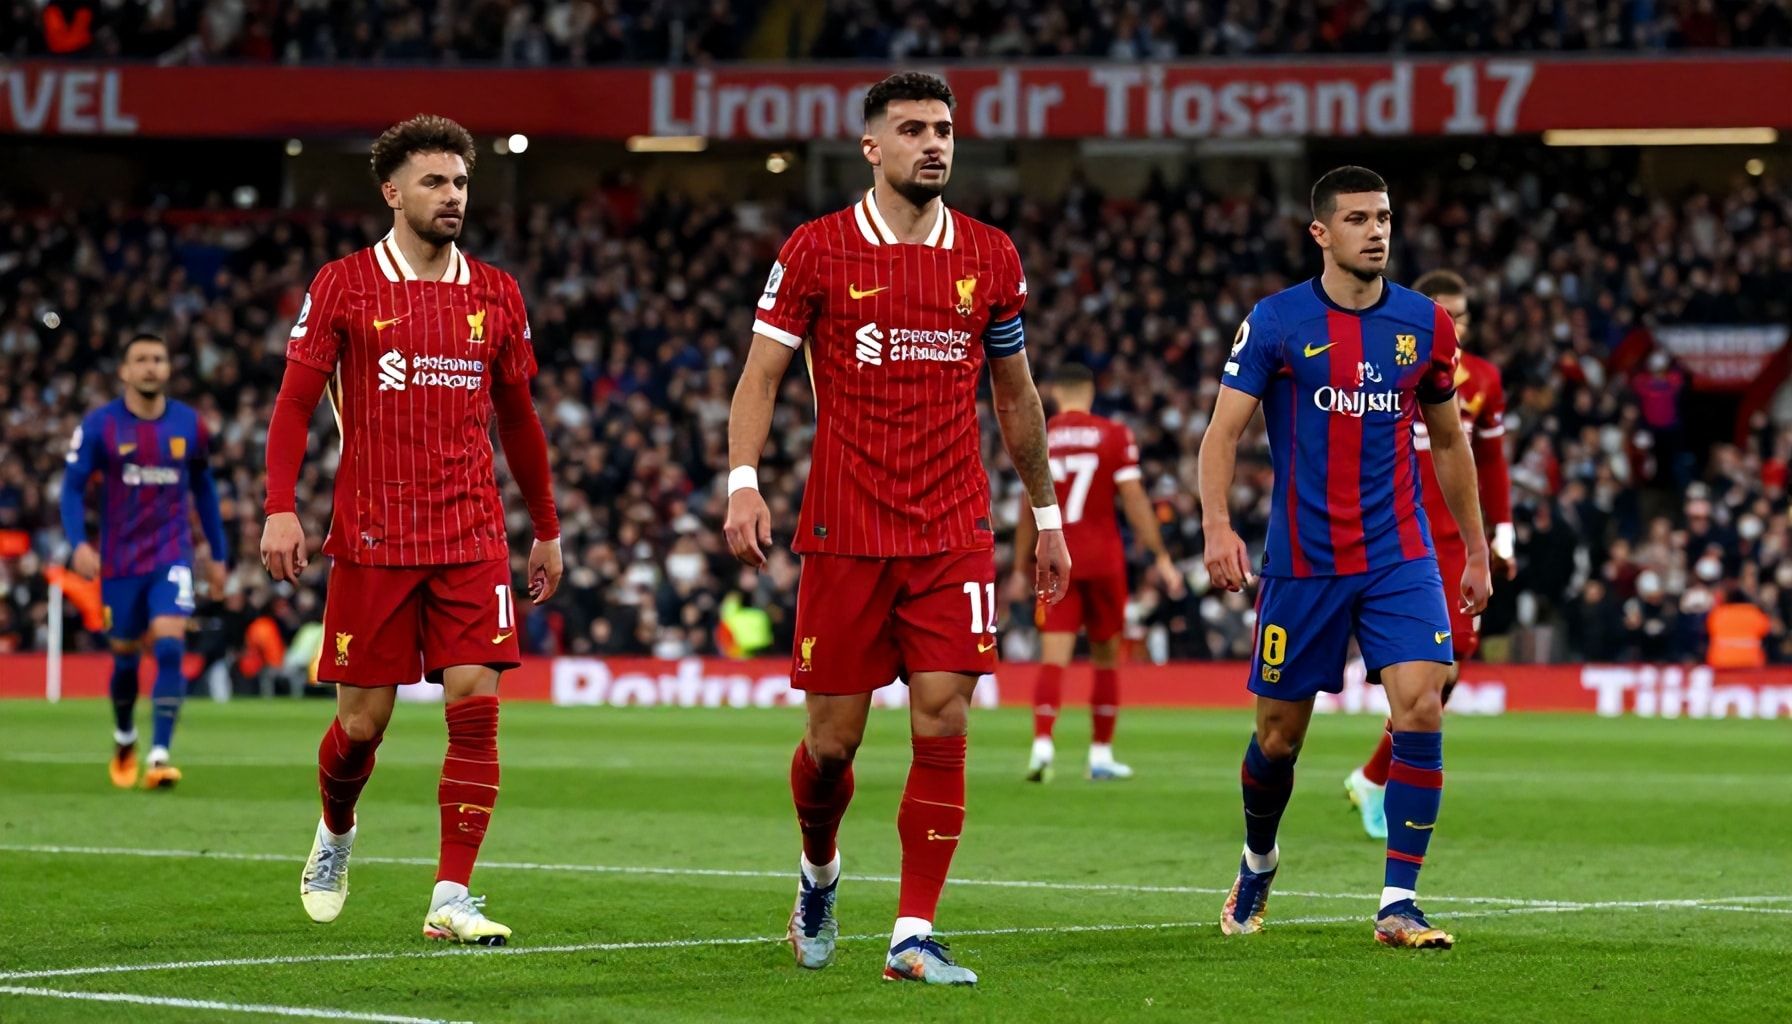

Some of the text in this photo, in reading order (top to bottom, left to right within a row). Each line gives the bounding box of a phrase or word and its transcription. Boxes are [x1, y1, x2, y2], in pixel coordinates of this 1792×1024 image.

[0, 69, 139, 133] VEL
[1443, 60, 1534, 135] 17
[963, 581, 997, 634] 11
